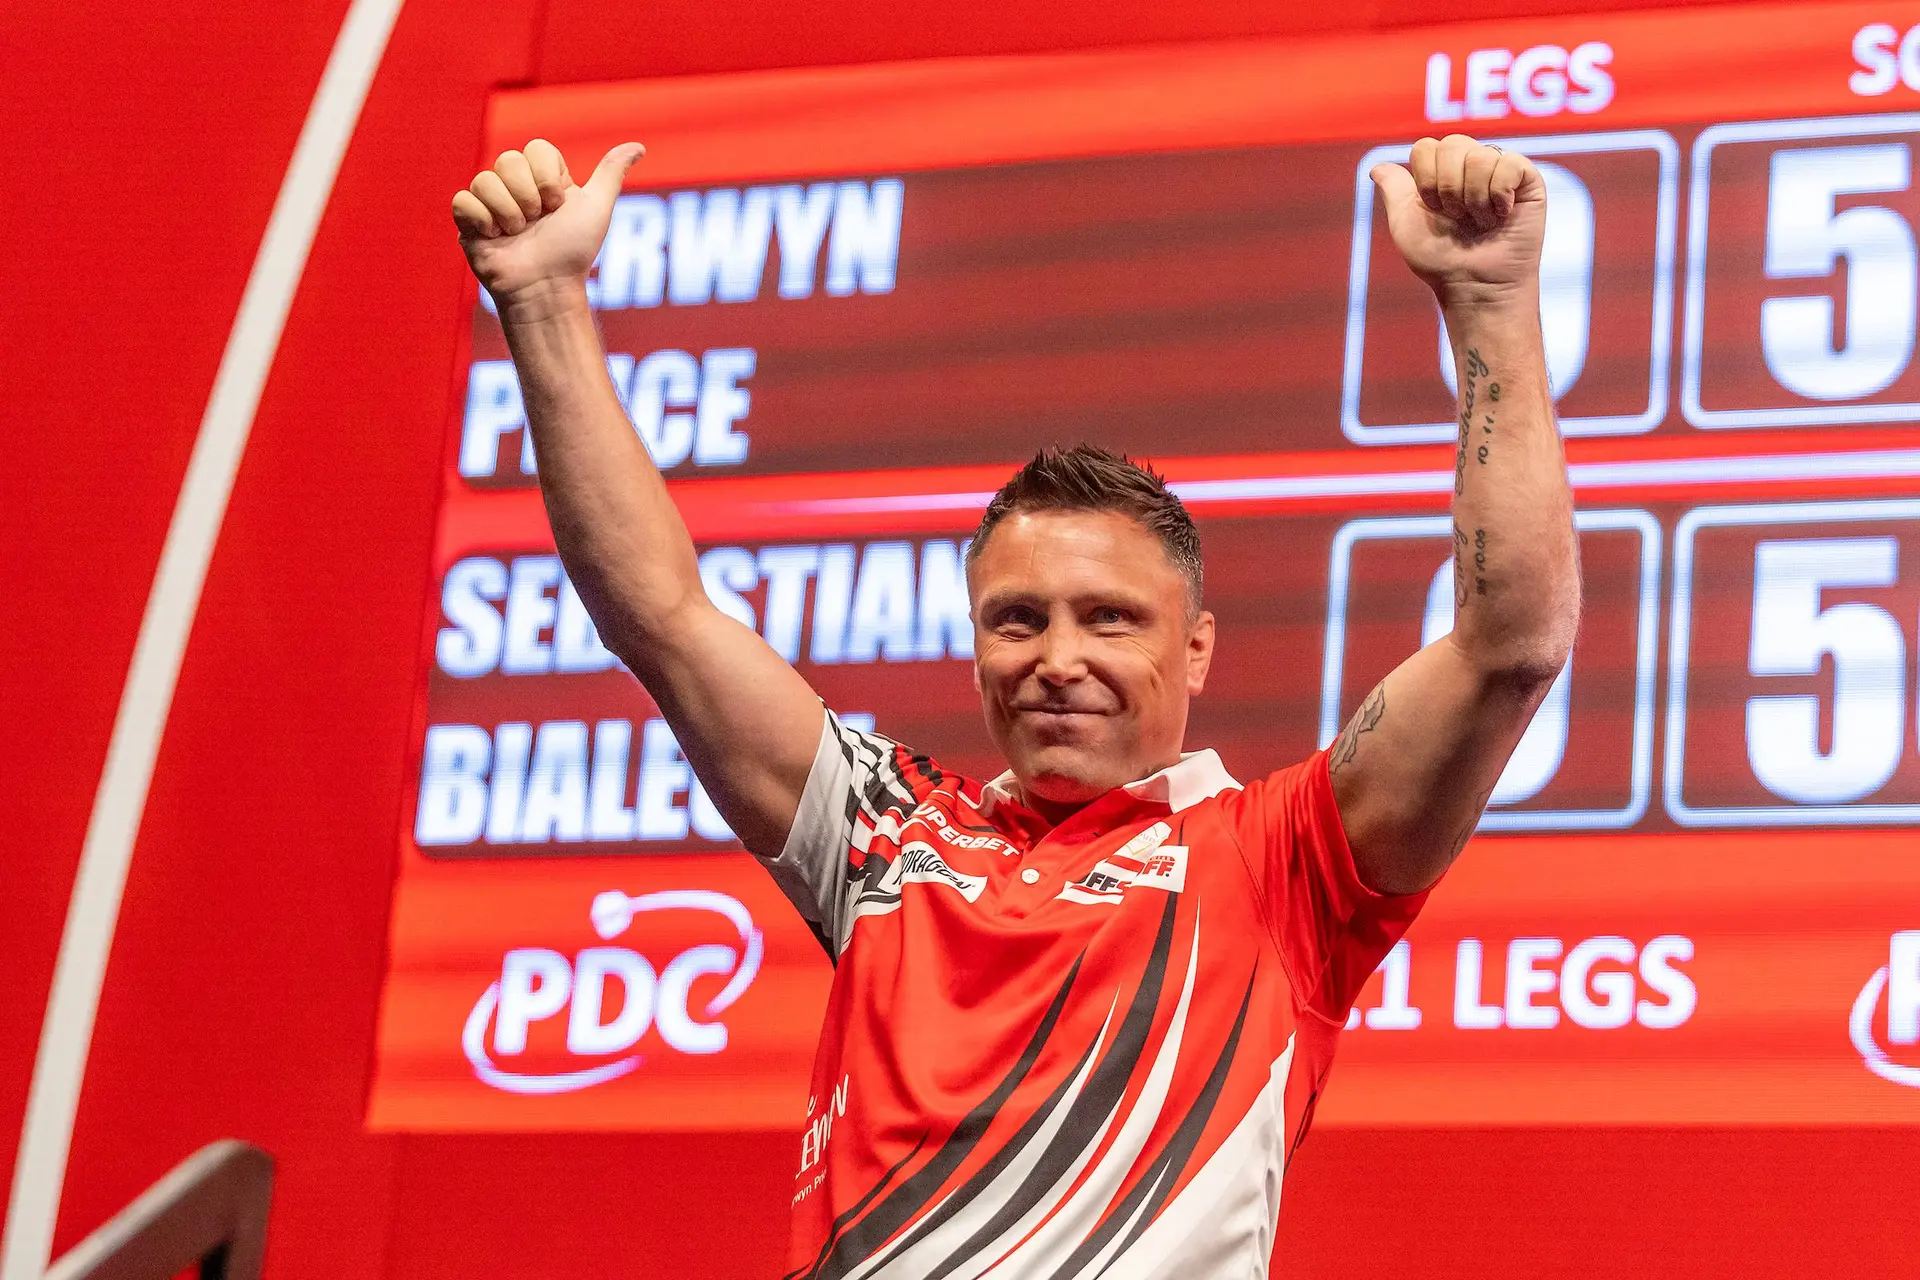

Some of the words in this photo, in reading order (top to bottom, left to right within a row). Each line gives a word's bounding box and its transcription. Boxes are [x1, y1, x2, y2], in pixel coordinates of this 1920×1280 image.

[1424, 42, 1615, 122] LEGS
[478, 179, 905, 316] RWYN
[1760, 143, 1917, 401] 5
[1745, 536, 1906, 805] 5
[913, 803, 1021, 857] UPERBET
[493, 943, 738, 1055] PDC
[1343, 937, 1422, 1030] 1
[1452, 934, 1698, 1030] LEGS
